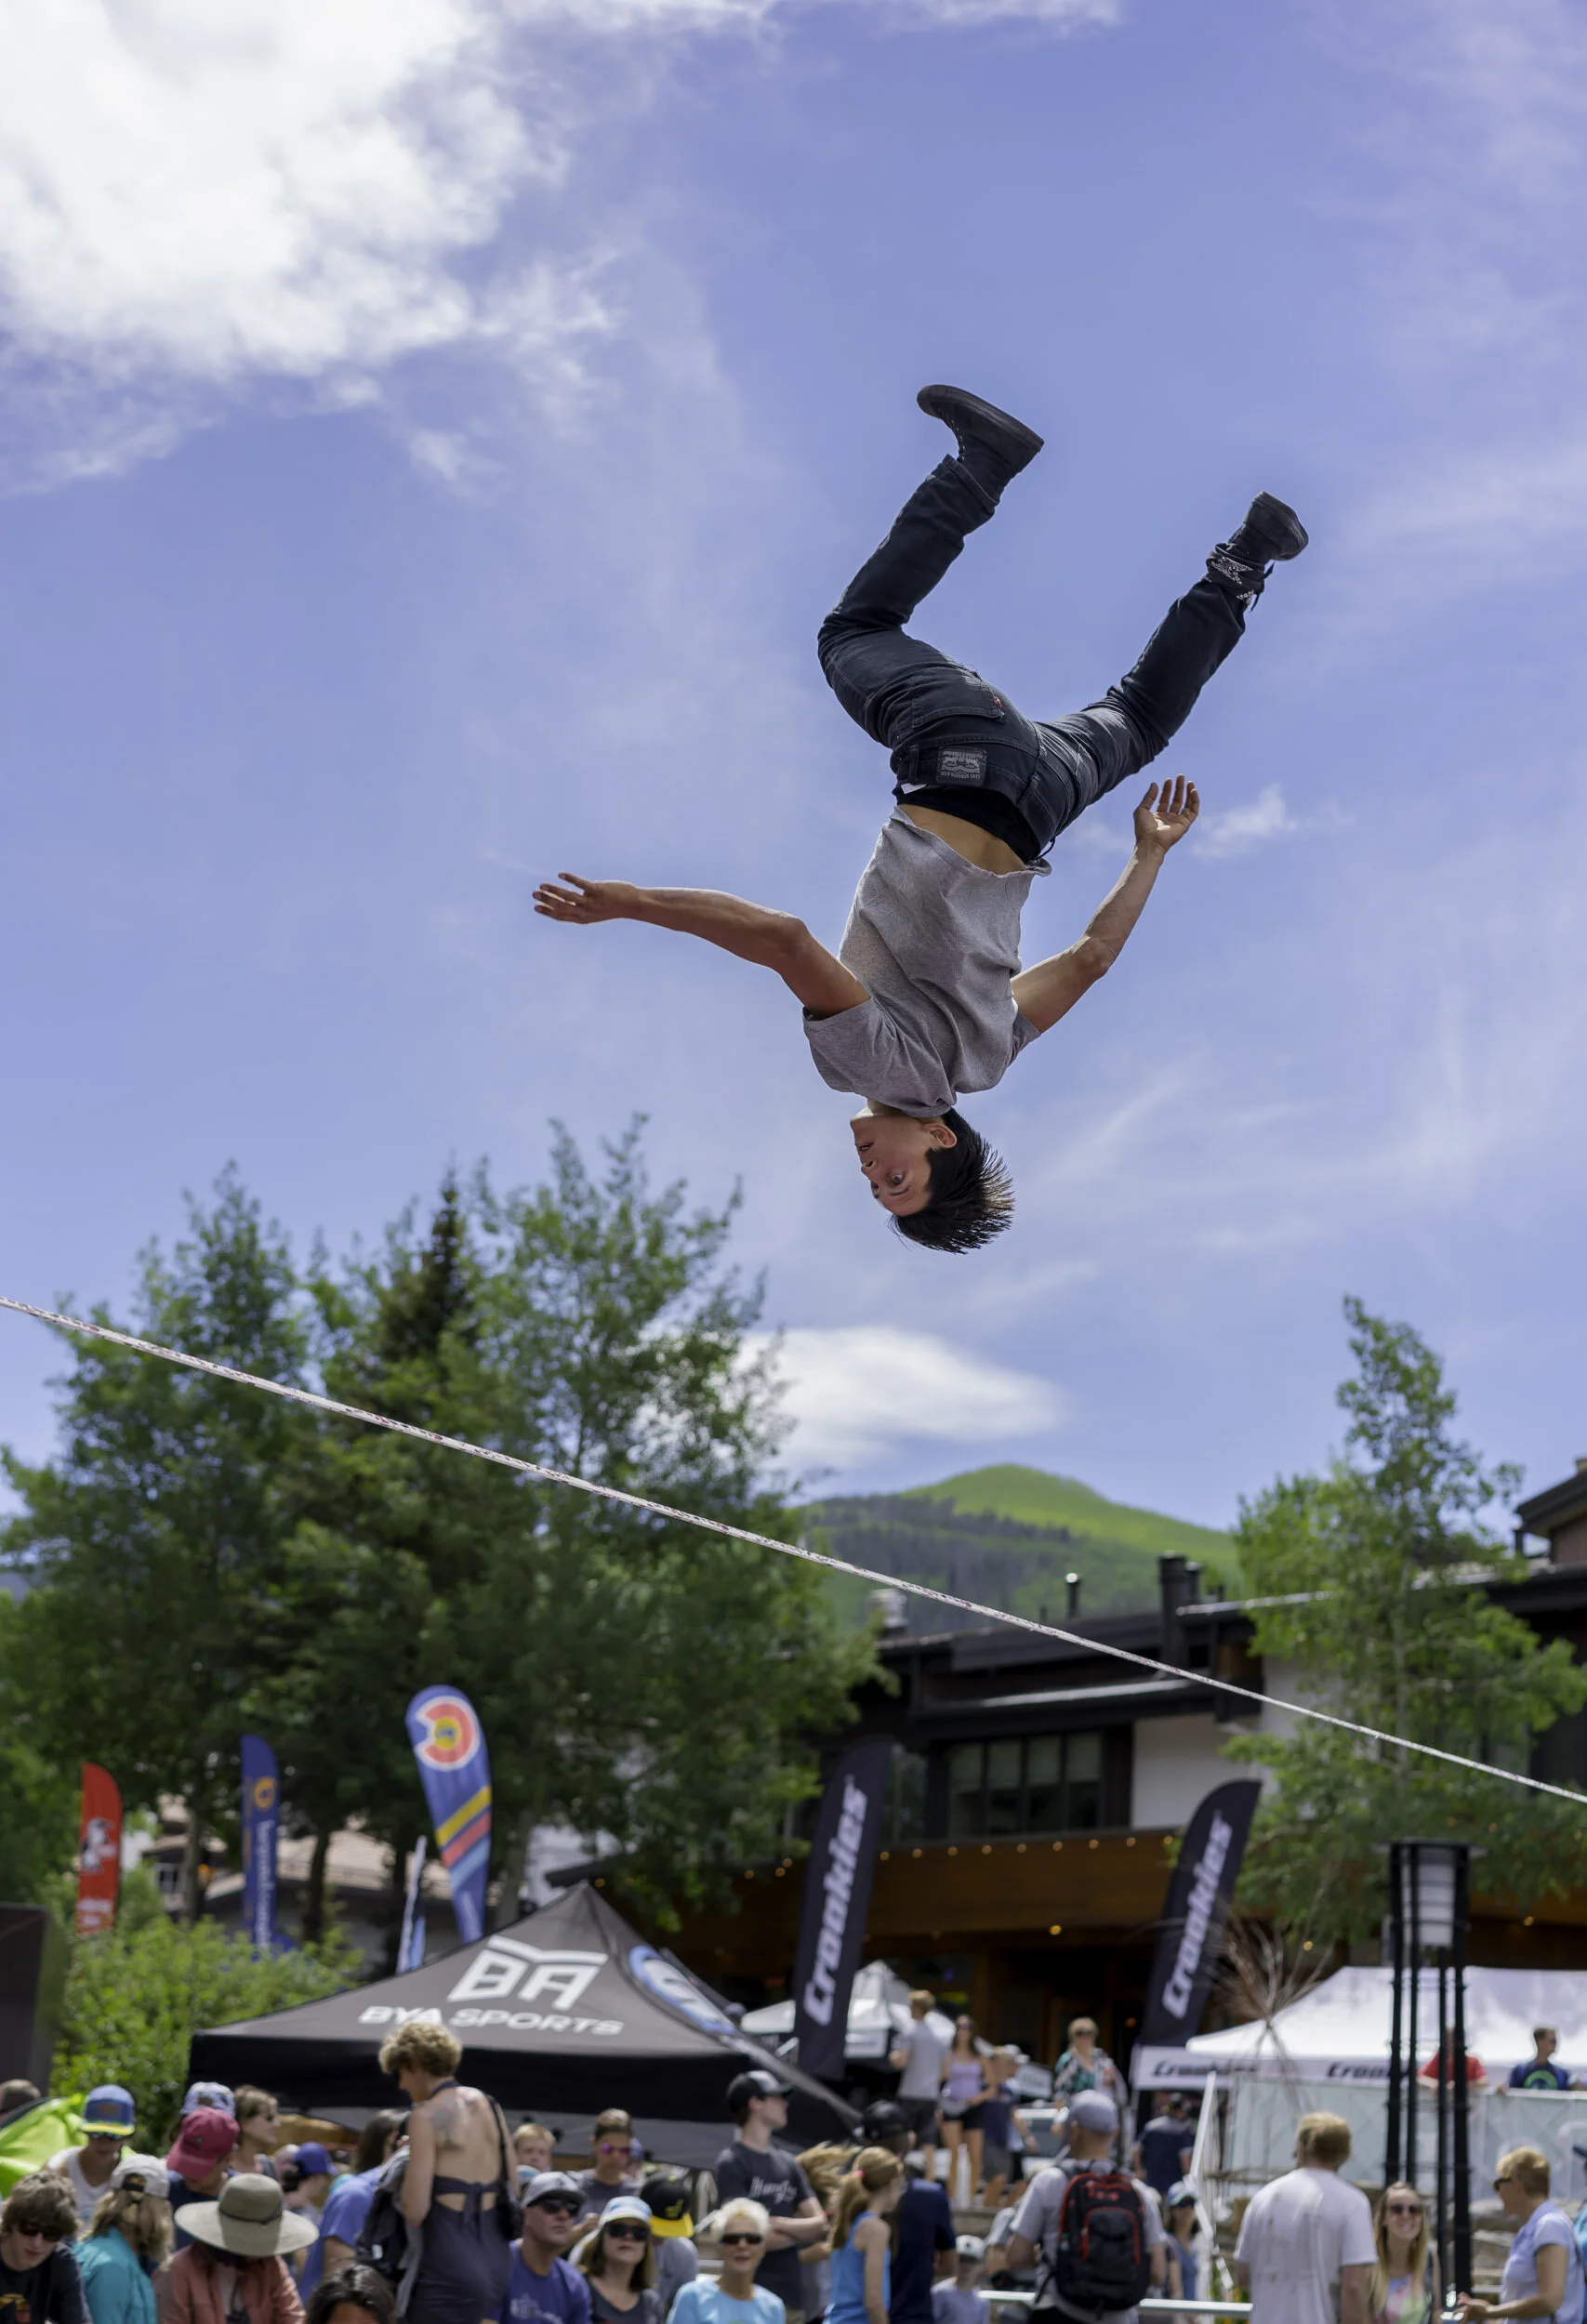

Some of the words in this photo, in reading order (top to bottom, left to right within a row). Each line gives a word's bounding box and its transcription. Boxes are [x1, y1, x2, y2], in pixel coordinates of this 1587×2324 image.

[803, 1781, 868, 2026] Croakies
[1162, 1813, 1233, 2020] Croakies
[358, 2005, 443, 2026] BYA
[449, 2007, 625, 2036] SPORTS
